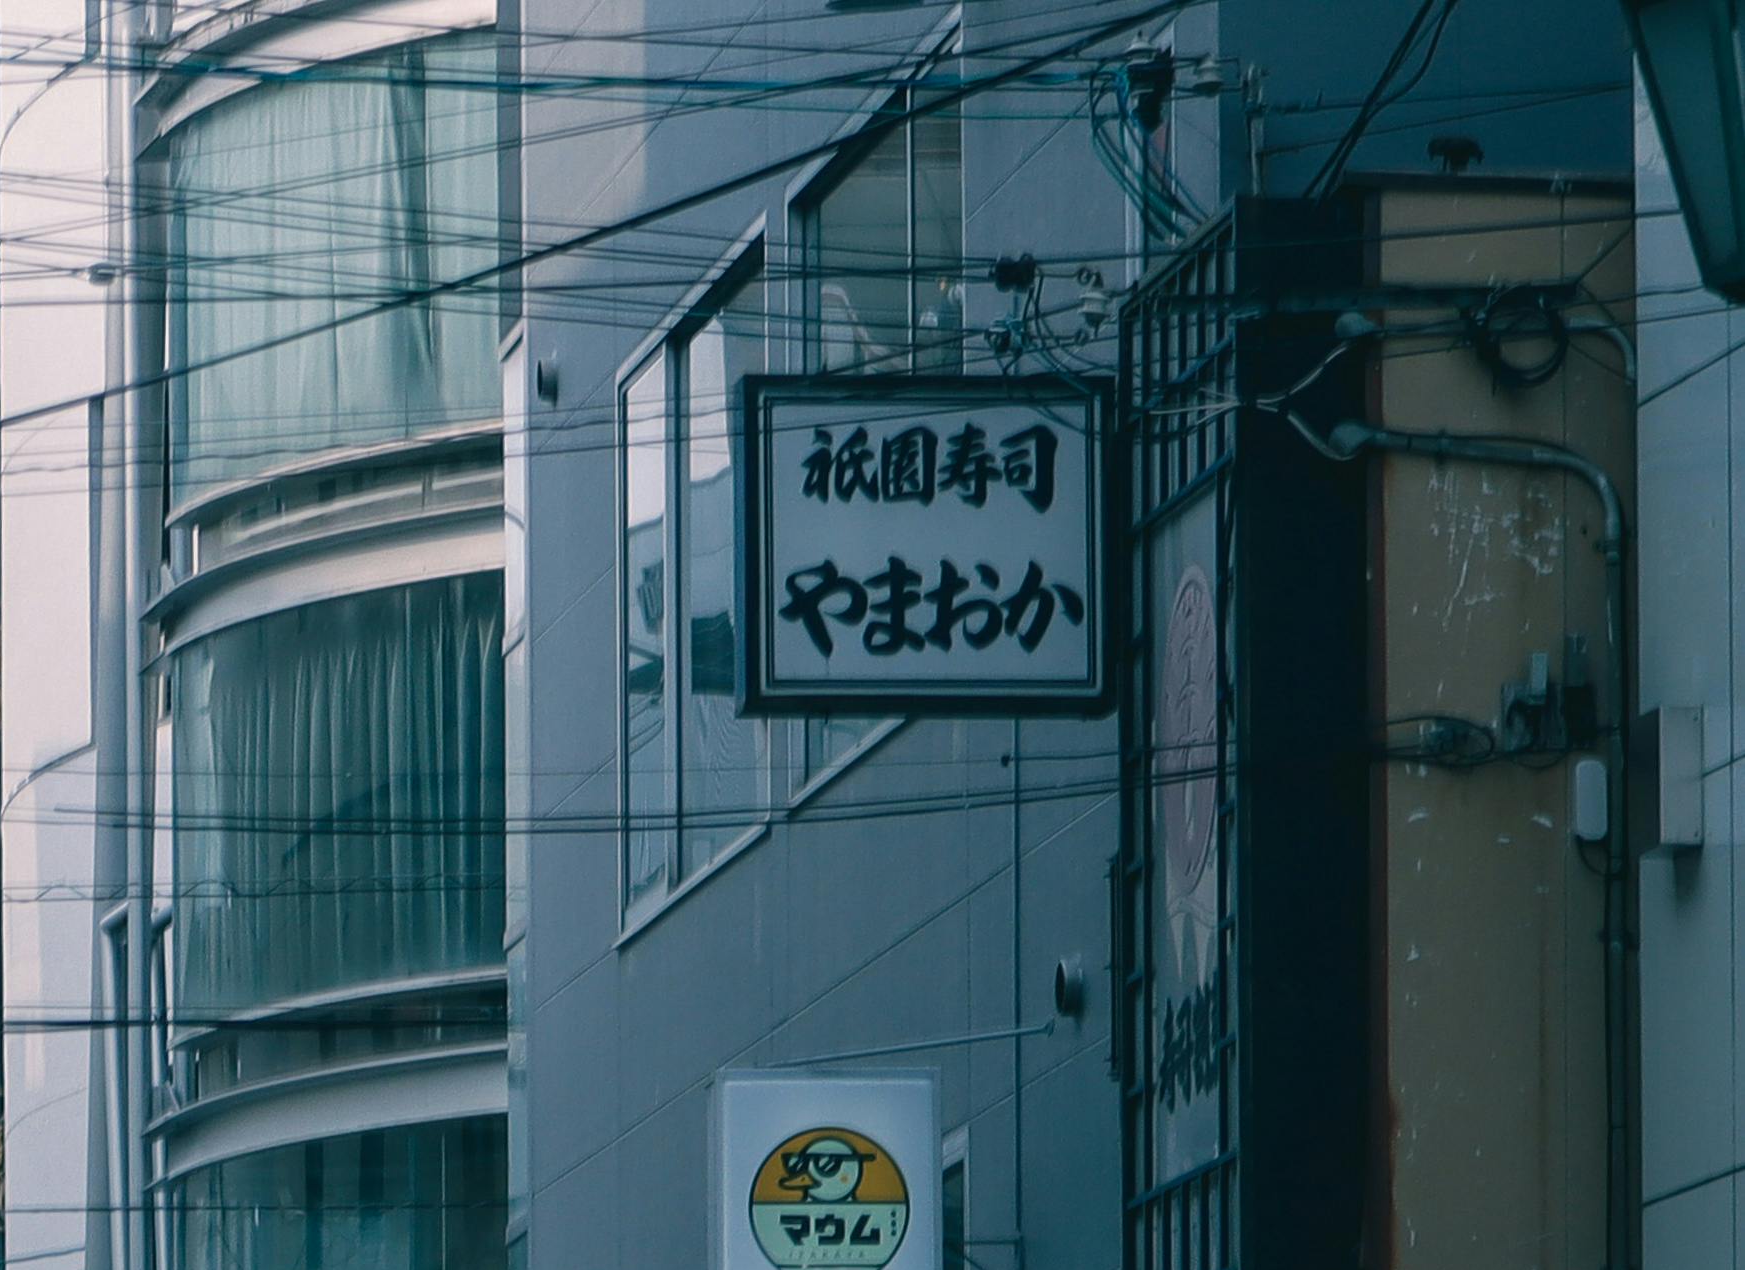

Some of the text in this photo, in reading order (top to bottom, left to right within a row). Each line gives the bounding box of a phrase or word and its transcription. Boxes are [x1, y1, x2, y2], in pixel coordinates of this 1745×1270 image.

[778, 555, 1086, 660] やまおか
[780, 1213, 880, 1245] マウム
